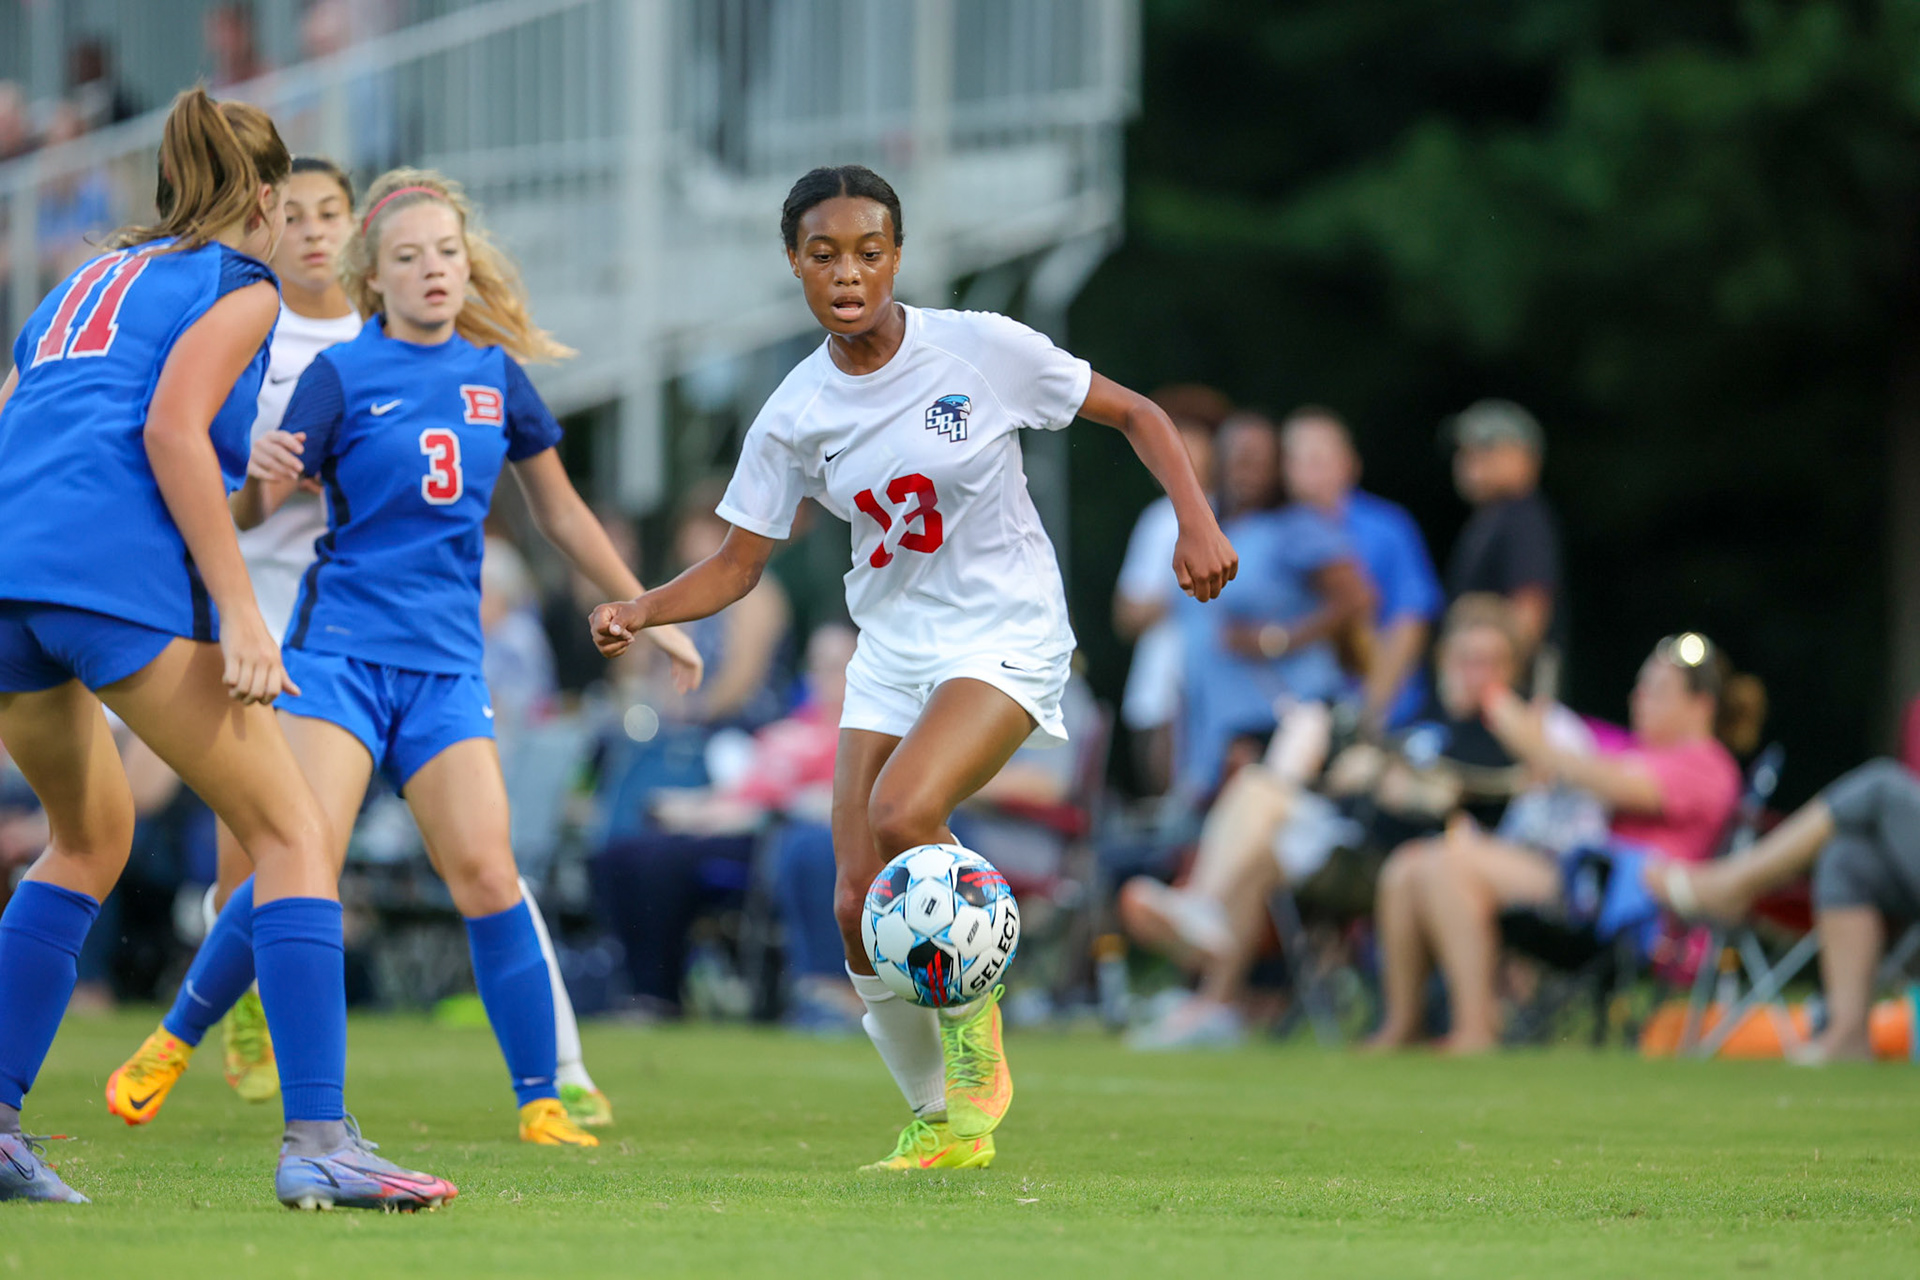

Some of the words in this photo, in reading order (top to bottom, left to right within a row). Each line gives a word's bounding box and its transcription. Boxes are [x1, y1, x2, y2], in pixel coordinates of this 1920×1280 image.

[31, 244, 171, 369] 11
[460, 384, 504, 426] B
[925, 406, 968, 442] SBA
[419, 428, 463, 505] 3
[853, 473, 943, 569] 13
[970, 906, 1016, 993] SELECT
